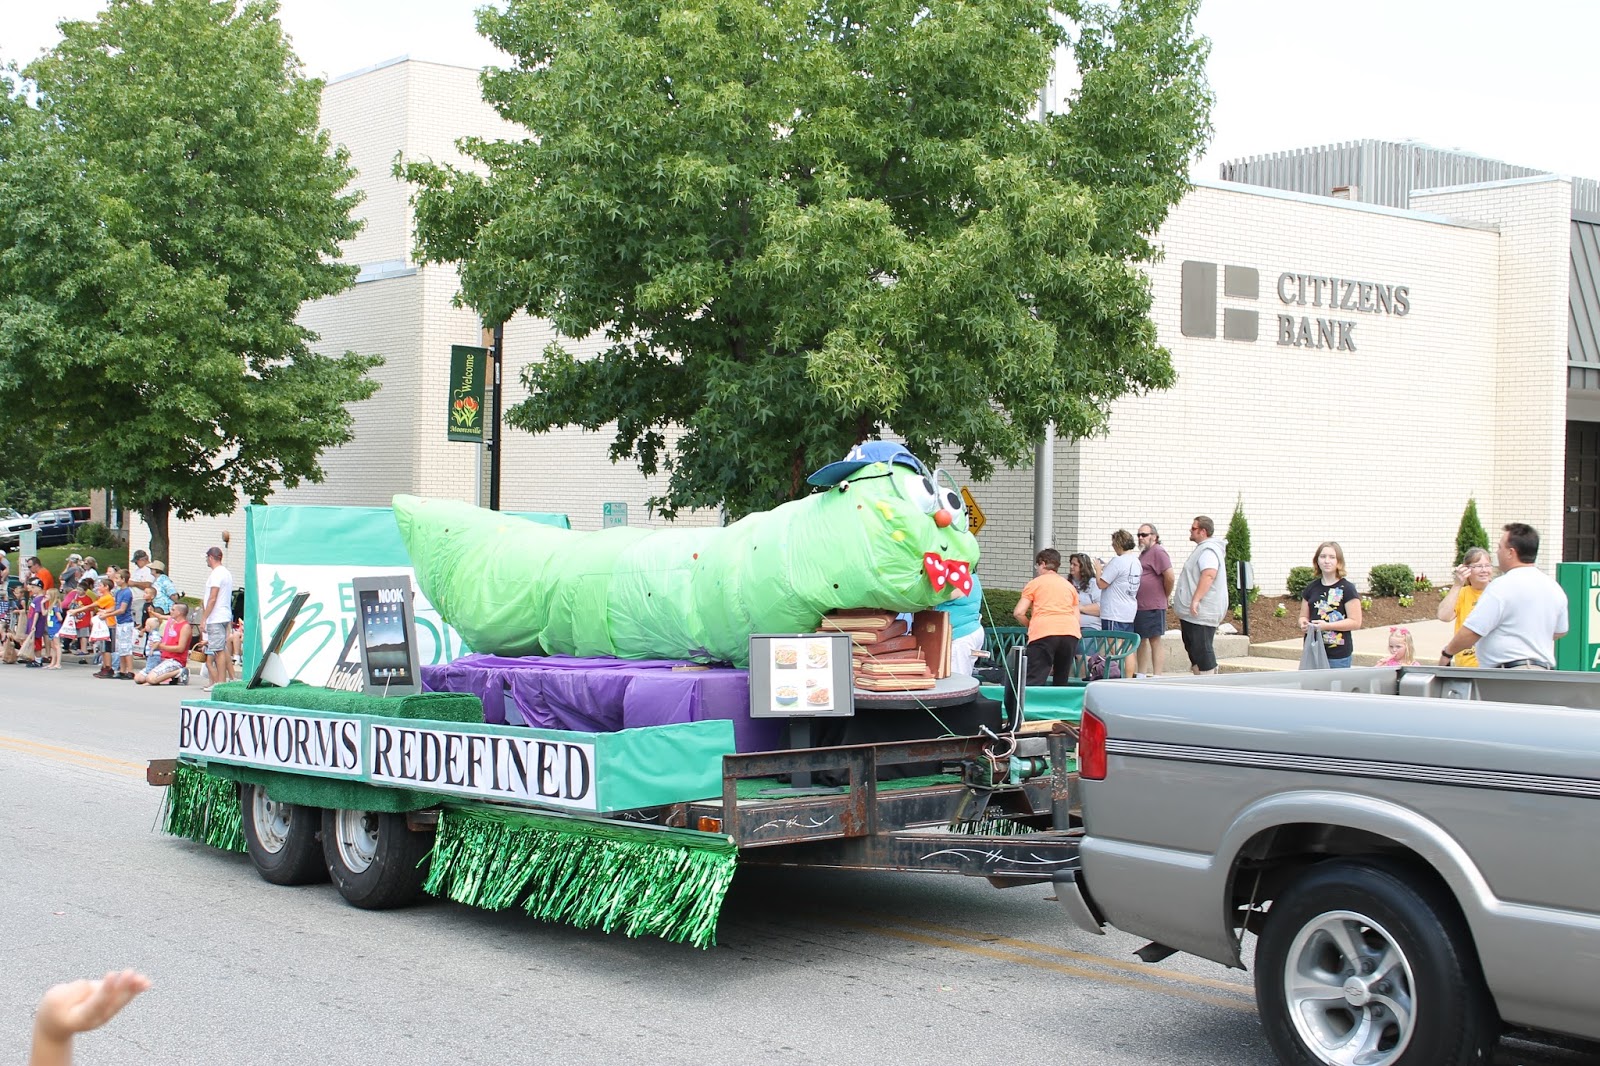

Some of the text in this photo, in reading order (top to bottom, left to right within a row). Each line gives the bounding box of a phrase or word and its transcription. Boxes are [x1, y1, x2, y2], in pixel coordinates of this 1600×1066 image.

[1277, 272, 1410, 316] CITIZENS
[1277, 314, 1357, 351] BANK
[459, 354, 475, 395] Welcome
[378, 588, 404, 603] NOOK
[180, 708, 590, 801] BOOKWORMS REDEFINED
